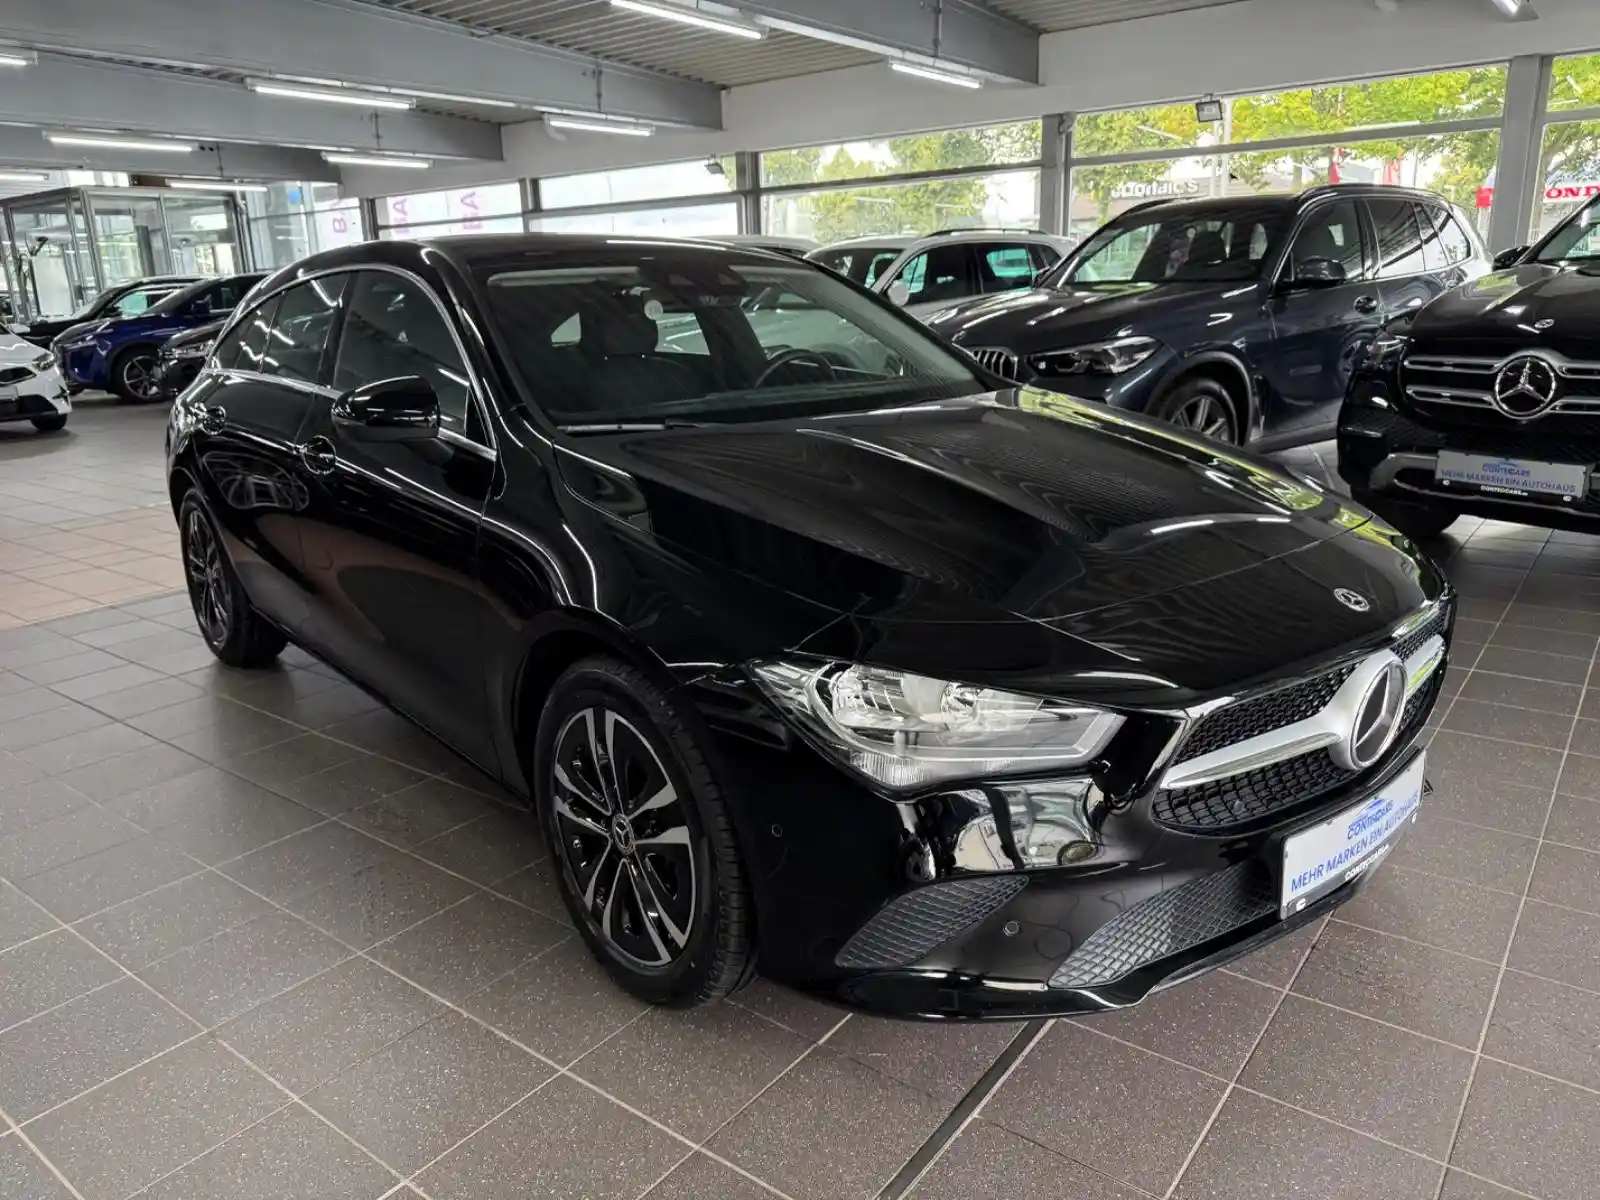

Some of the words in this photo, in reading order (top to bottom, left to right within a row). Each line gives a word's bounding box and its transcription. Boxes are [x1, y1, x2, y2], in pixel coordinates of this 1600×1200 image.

[1466, 474, 1504, 485] MARKEN
[1505, 478, 1520, 487] EIN
[1521, 480, 1576, 493] AUTOHAUS
[1291, 864, 1324, 893] MEHR
[1326, 838, 1369, 874] MARKEN
[1369, 828, 1382, 845] EIN
